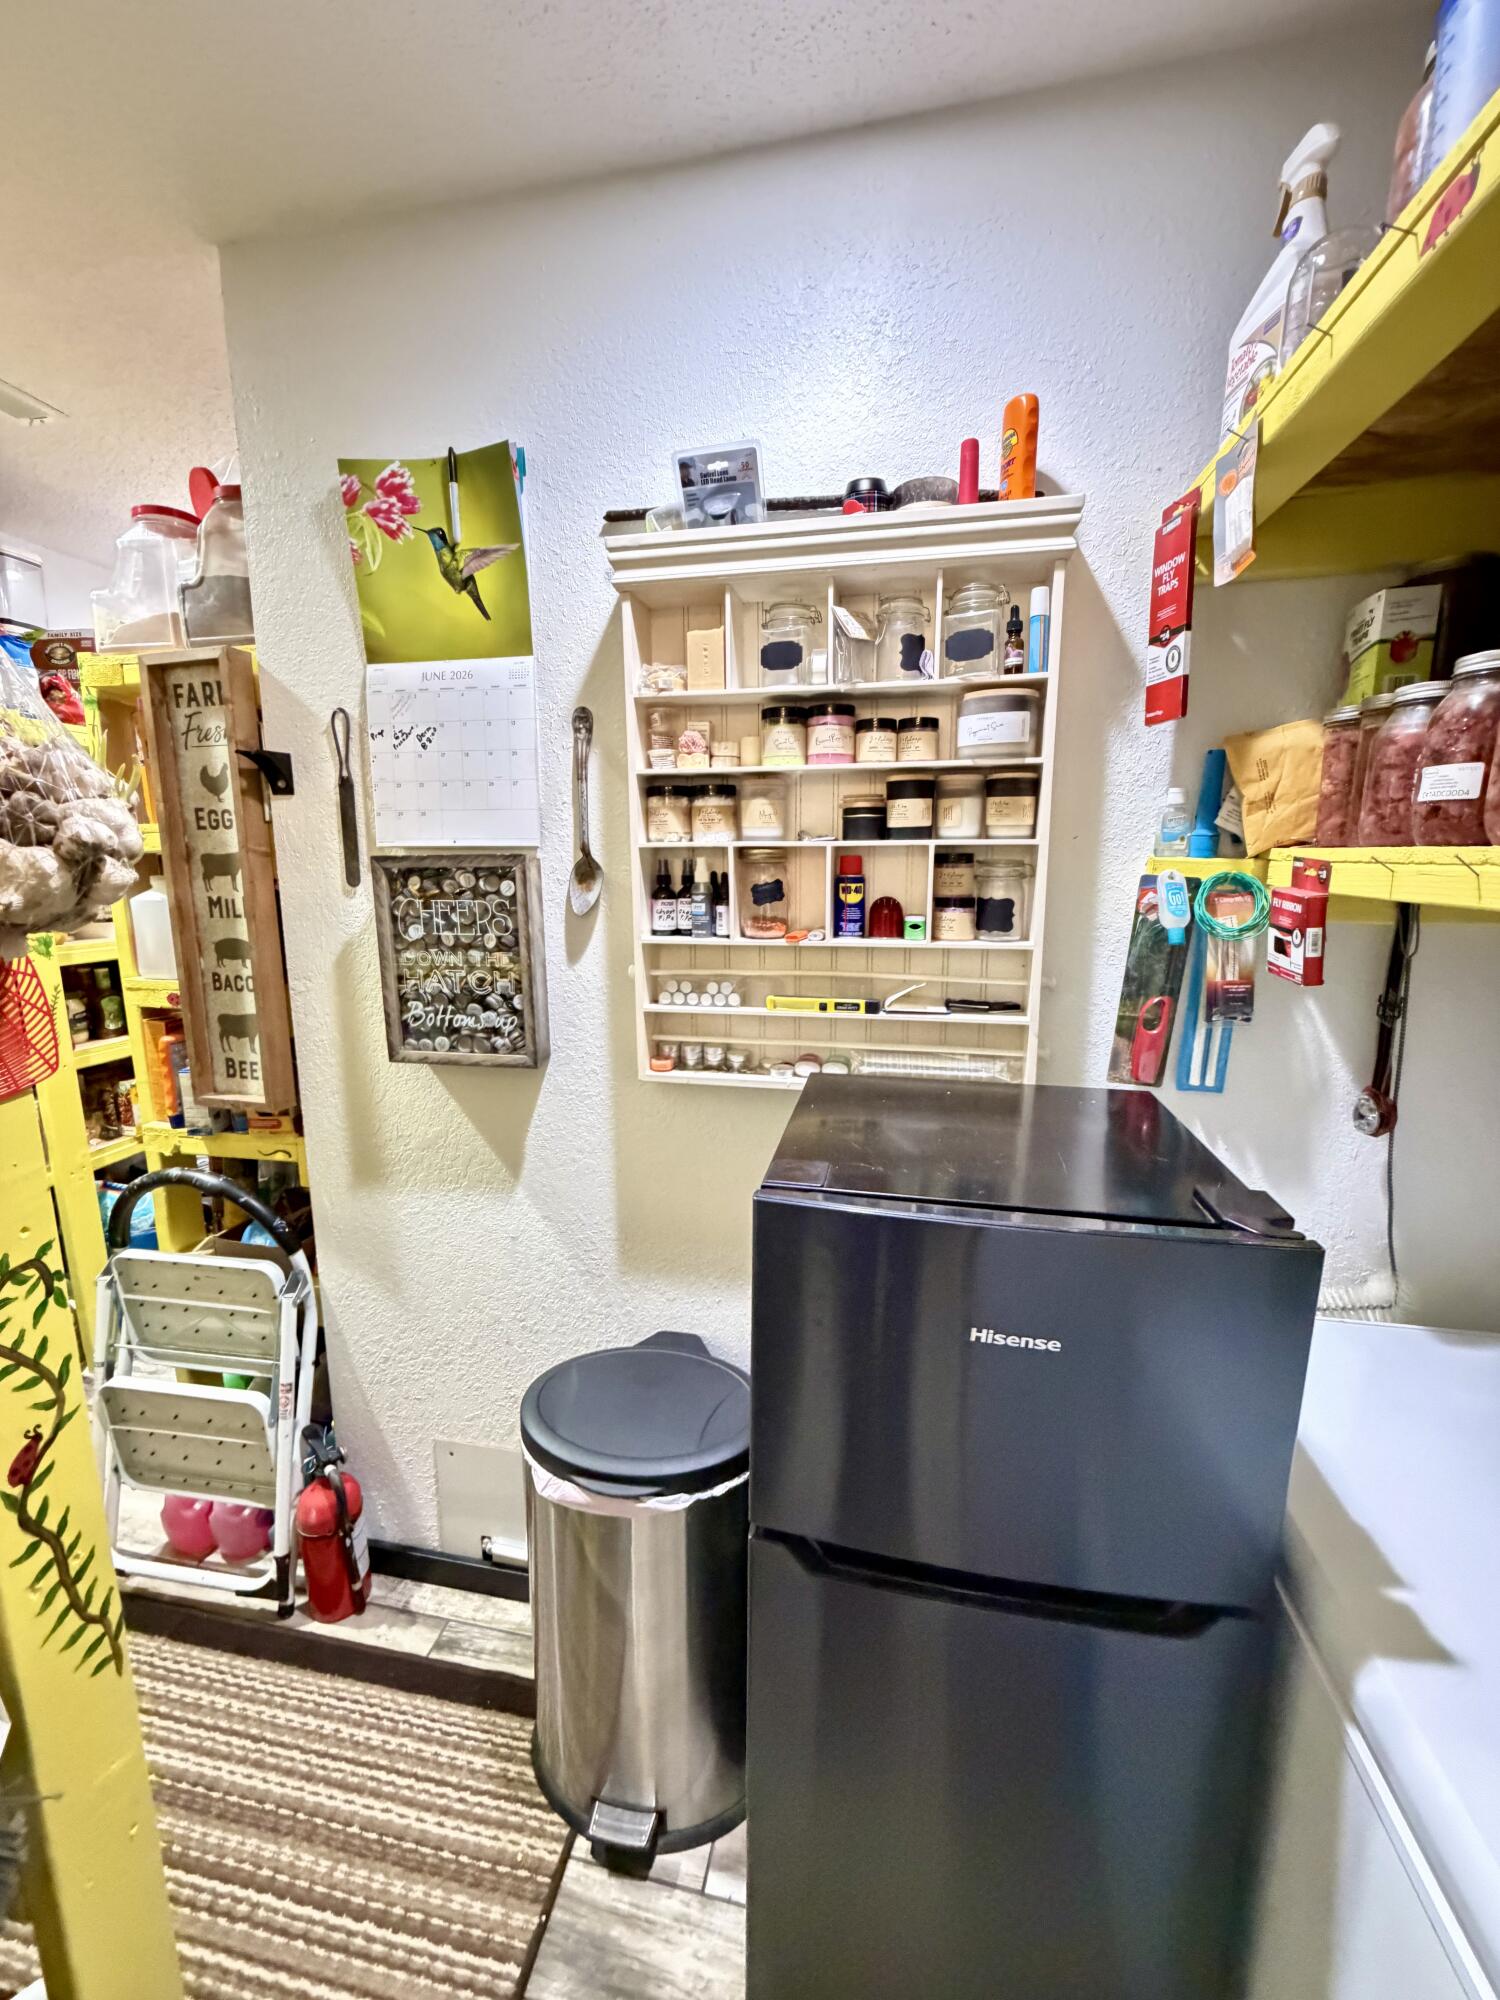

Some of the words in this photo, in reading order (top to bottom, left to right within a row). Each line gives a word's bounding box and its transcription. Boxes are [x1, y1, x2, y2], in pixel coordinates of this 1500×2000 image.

[1154, 551, 1186, 578] WINDOW
[1157, 577, 1179, 597] TRAPS
[1162, 569, 1175, 584] FLY
[421, 671, 446, 682] JUNE
[450, 670, 474, 680] 2026
[207, 895, 244, 918] MIL
[1273, 897, 1282, 908] FLY
[1281, 900, 1303, 913] RIBBON
[398, 898, 513, 942] CHEERS
[401, 951, 462, 967] DOWN
[471, 951, 514, 968] THE
[403, 969, 516, 996] HATCH
[402, 1000, 485, 1029] Bottoms
[495, 1015, 518, 1036] up
[970, 1327, 1062, 1352] Hisense
